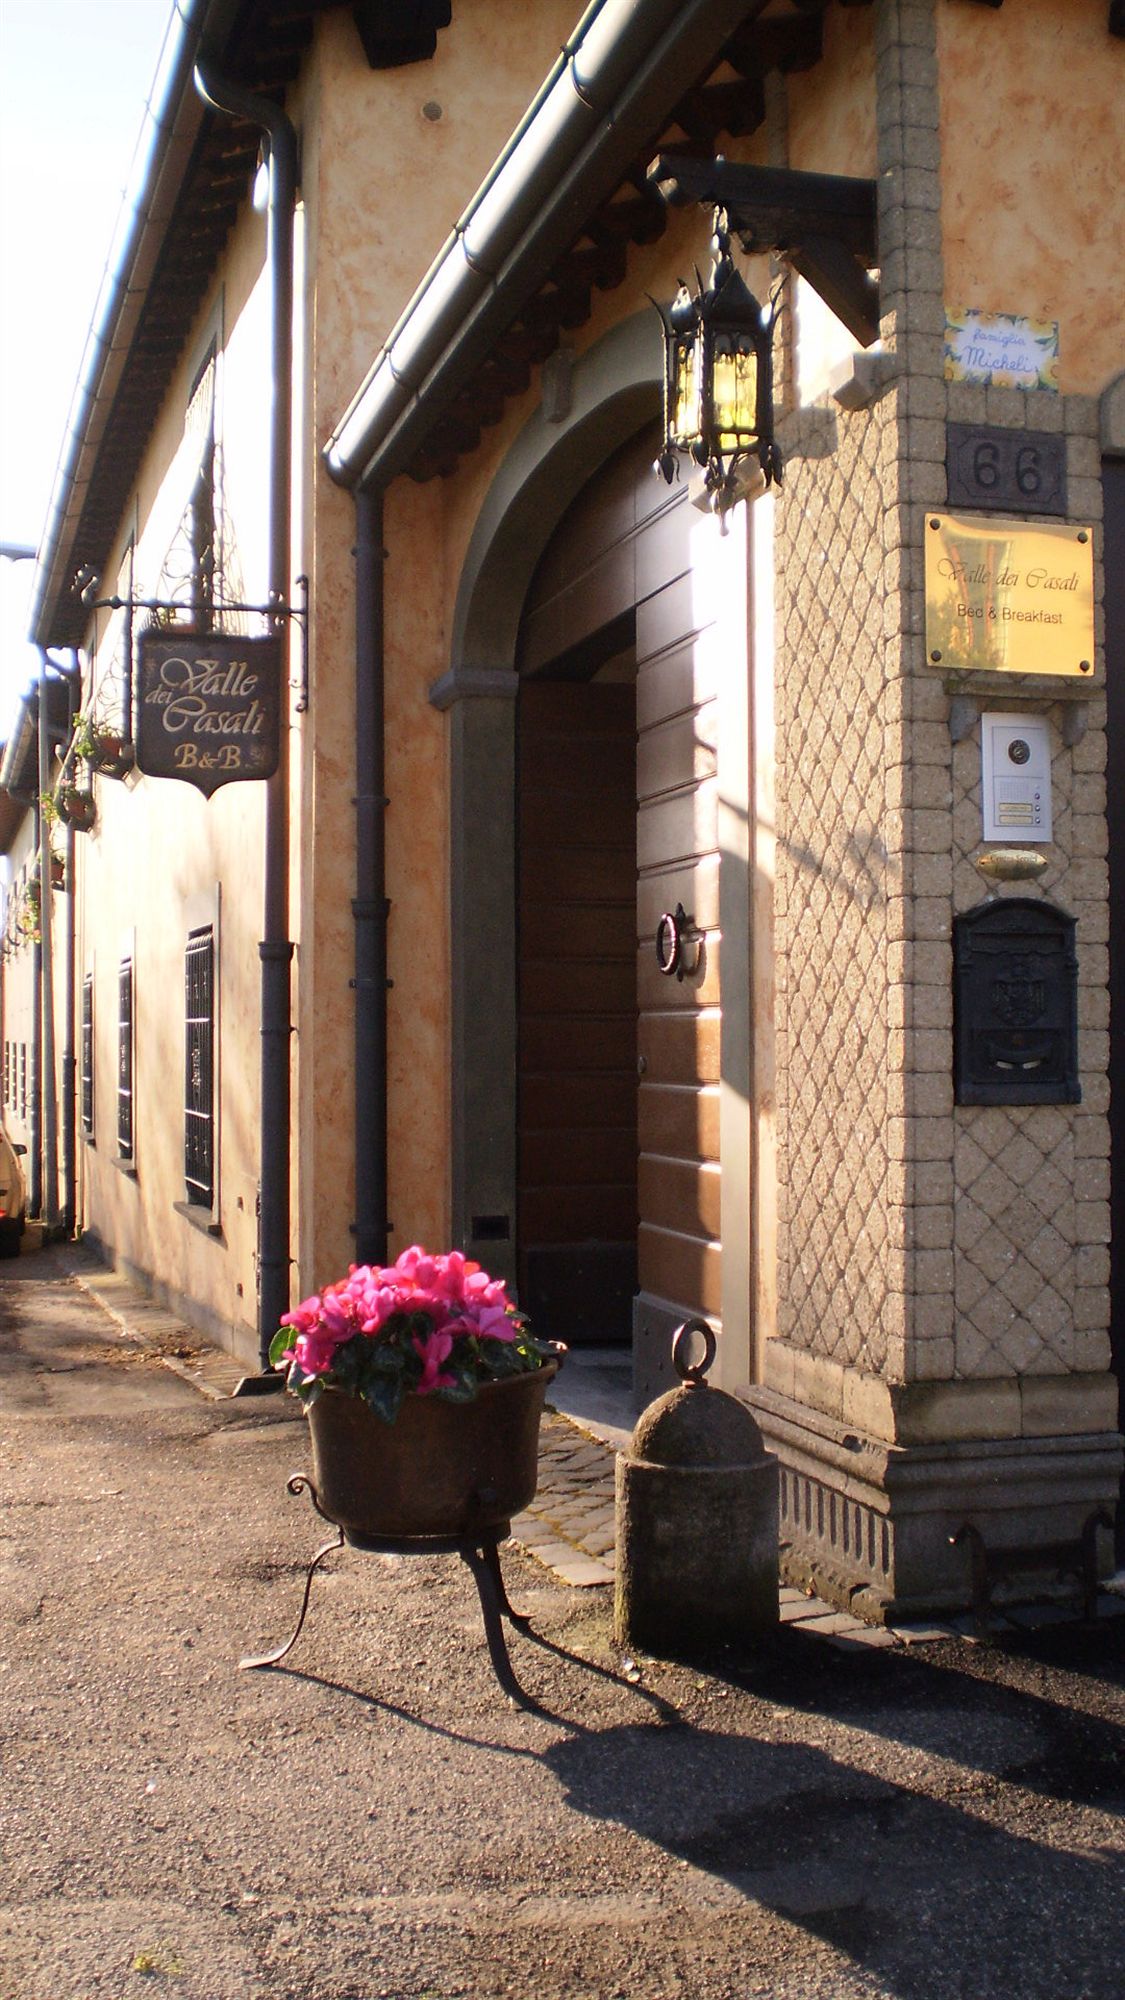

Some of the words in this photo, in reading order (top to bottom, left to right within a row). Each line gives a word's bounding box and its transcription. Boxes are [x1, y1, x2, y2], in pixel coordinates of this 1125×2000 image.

[963, 344, 1034, 374] Micheli
[973, 442, 1042, 496] 66
[937, 557, 991, 584] Valle
[995, 566, 1019, 586] dei
[1025, 567, 1079, 592] Casali
[957, 603, 983, 618] Bed
[988, 606, 997, 619] &
[1002, 607, 1063, 625] Breakfast
[160, 657, 258, 696] Valle
[144, 684, 174, 704] dei
[162, 695, 267, 735] Casali
[173, 743, 241, 769] B&B
